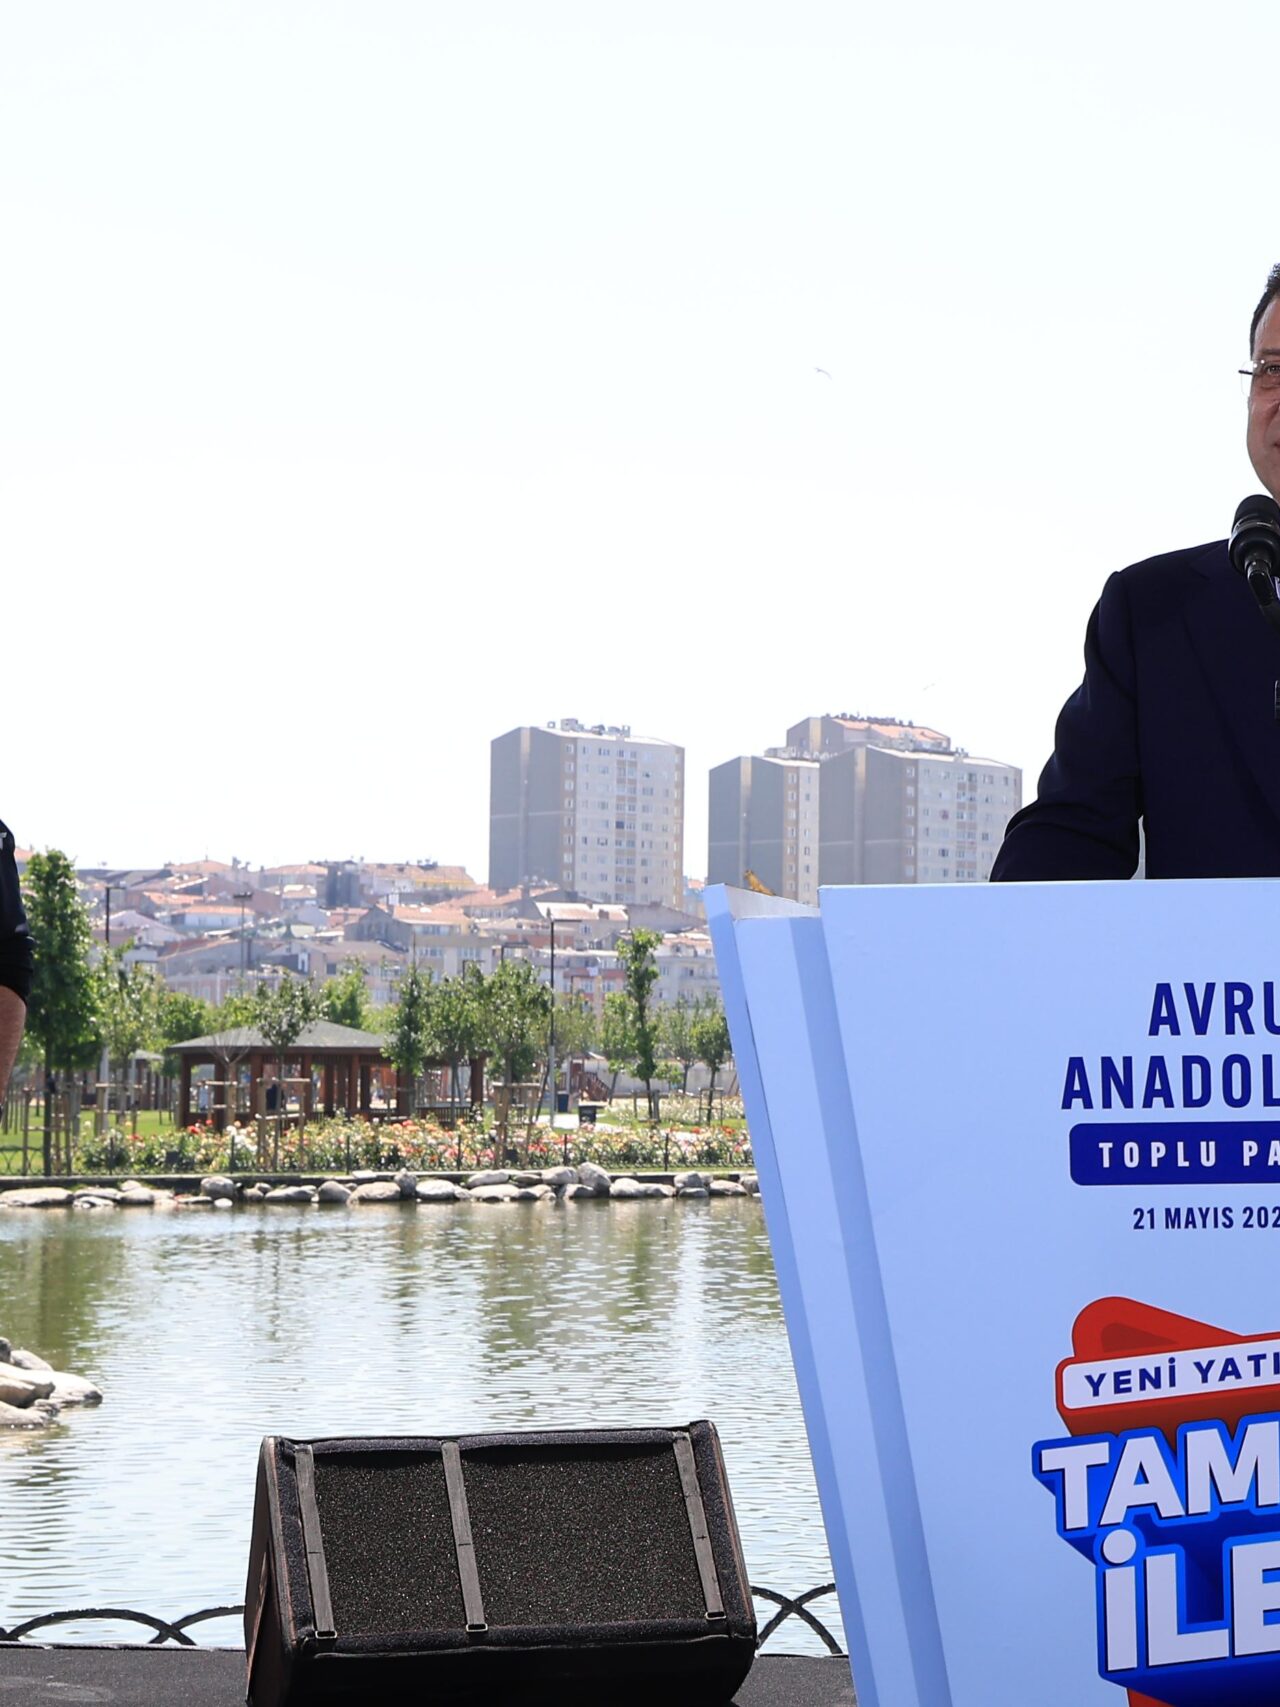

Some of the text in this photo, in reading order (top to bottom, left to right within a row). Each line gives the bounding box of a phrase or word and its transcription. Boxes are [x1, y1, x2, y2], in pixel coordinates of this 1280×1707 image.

[1099, 1141, 1217, 1168] TOPLU
[1133, 1207, 1157, 1230] 21
[1165, 1207, 1235, 1230] MAYIS
[1084, 1357, 1178, 1397] YENİ
[1040, 1420, 1280, 1531] TAM
